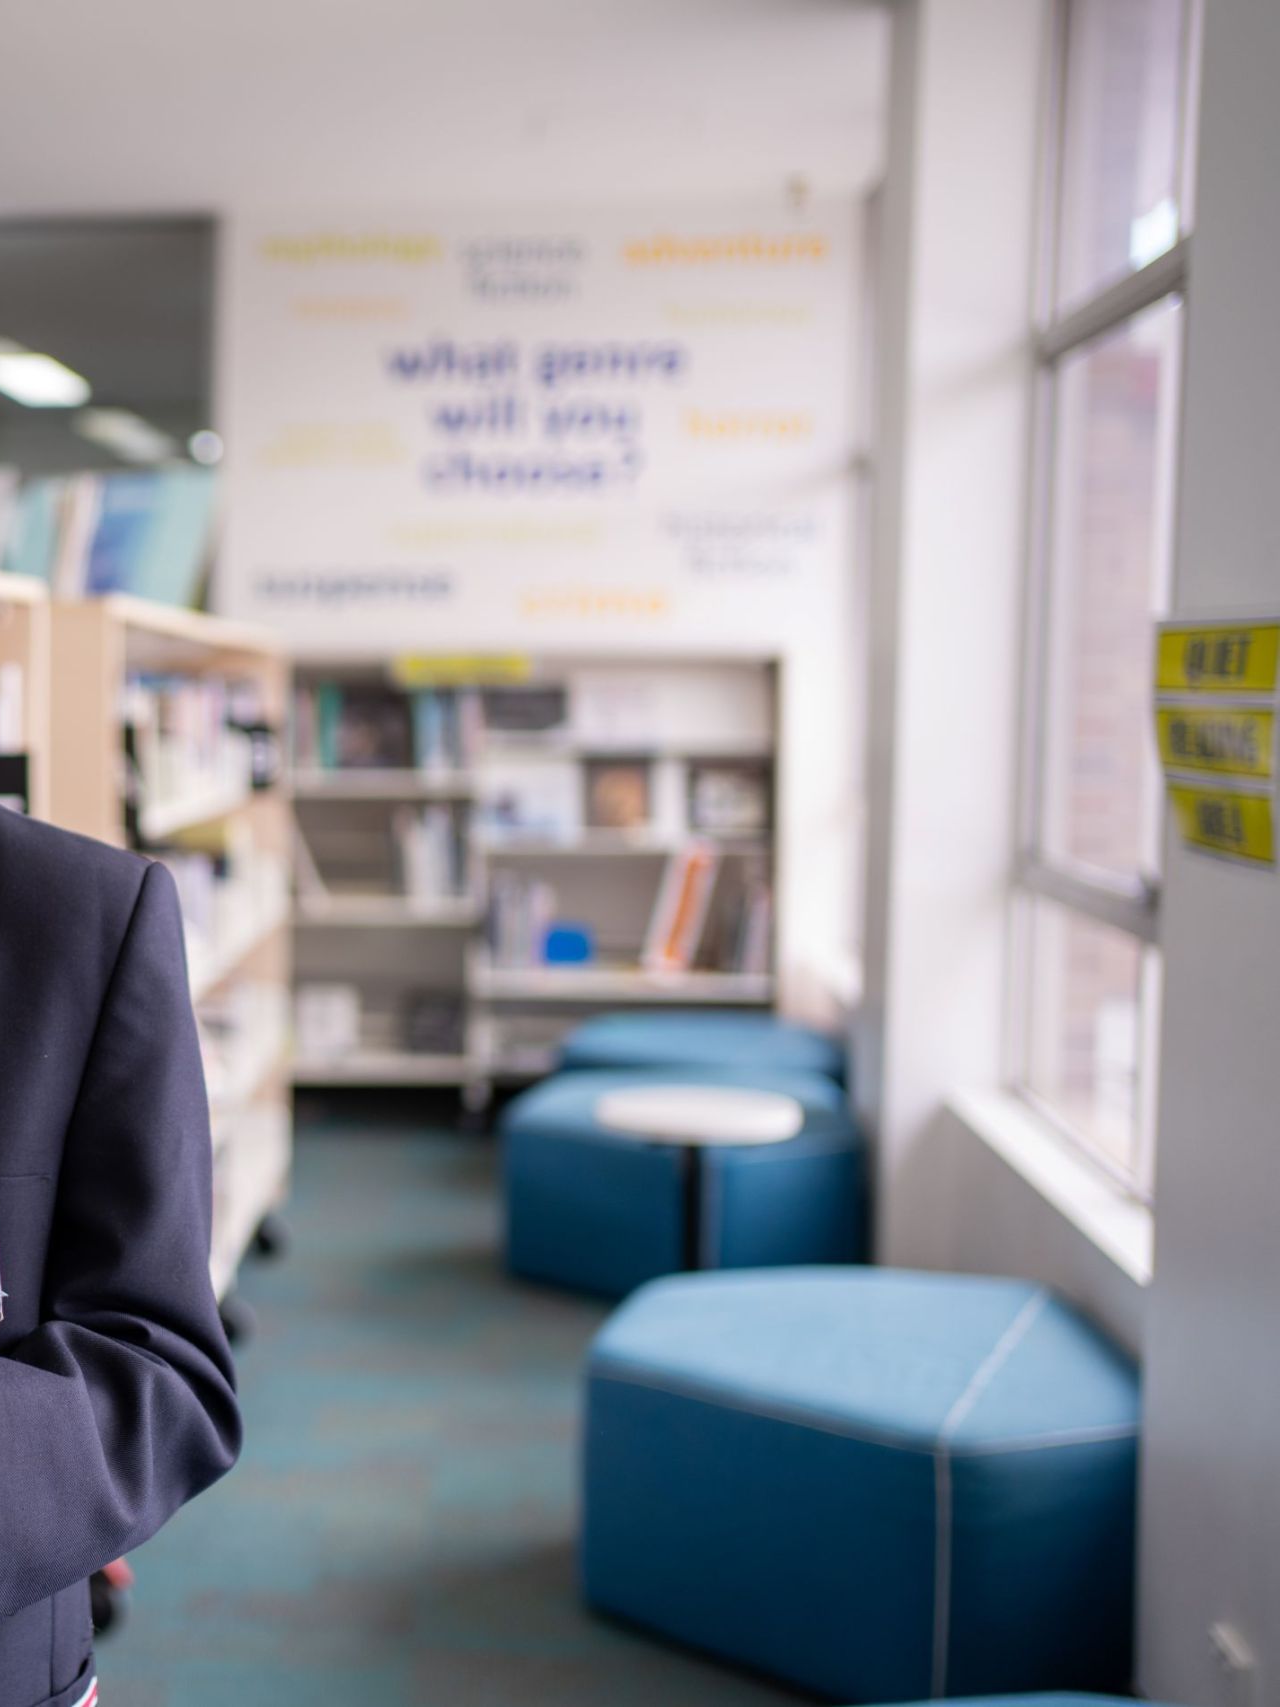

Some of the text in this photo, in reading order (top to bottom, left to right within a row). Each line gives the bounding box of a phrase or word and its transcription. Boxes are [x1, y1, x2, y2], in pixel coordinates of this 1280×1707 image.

[386, 338, 687, 390] what genre
[432, 397, 638, 447] will you
